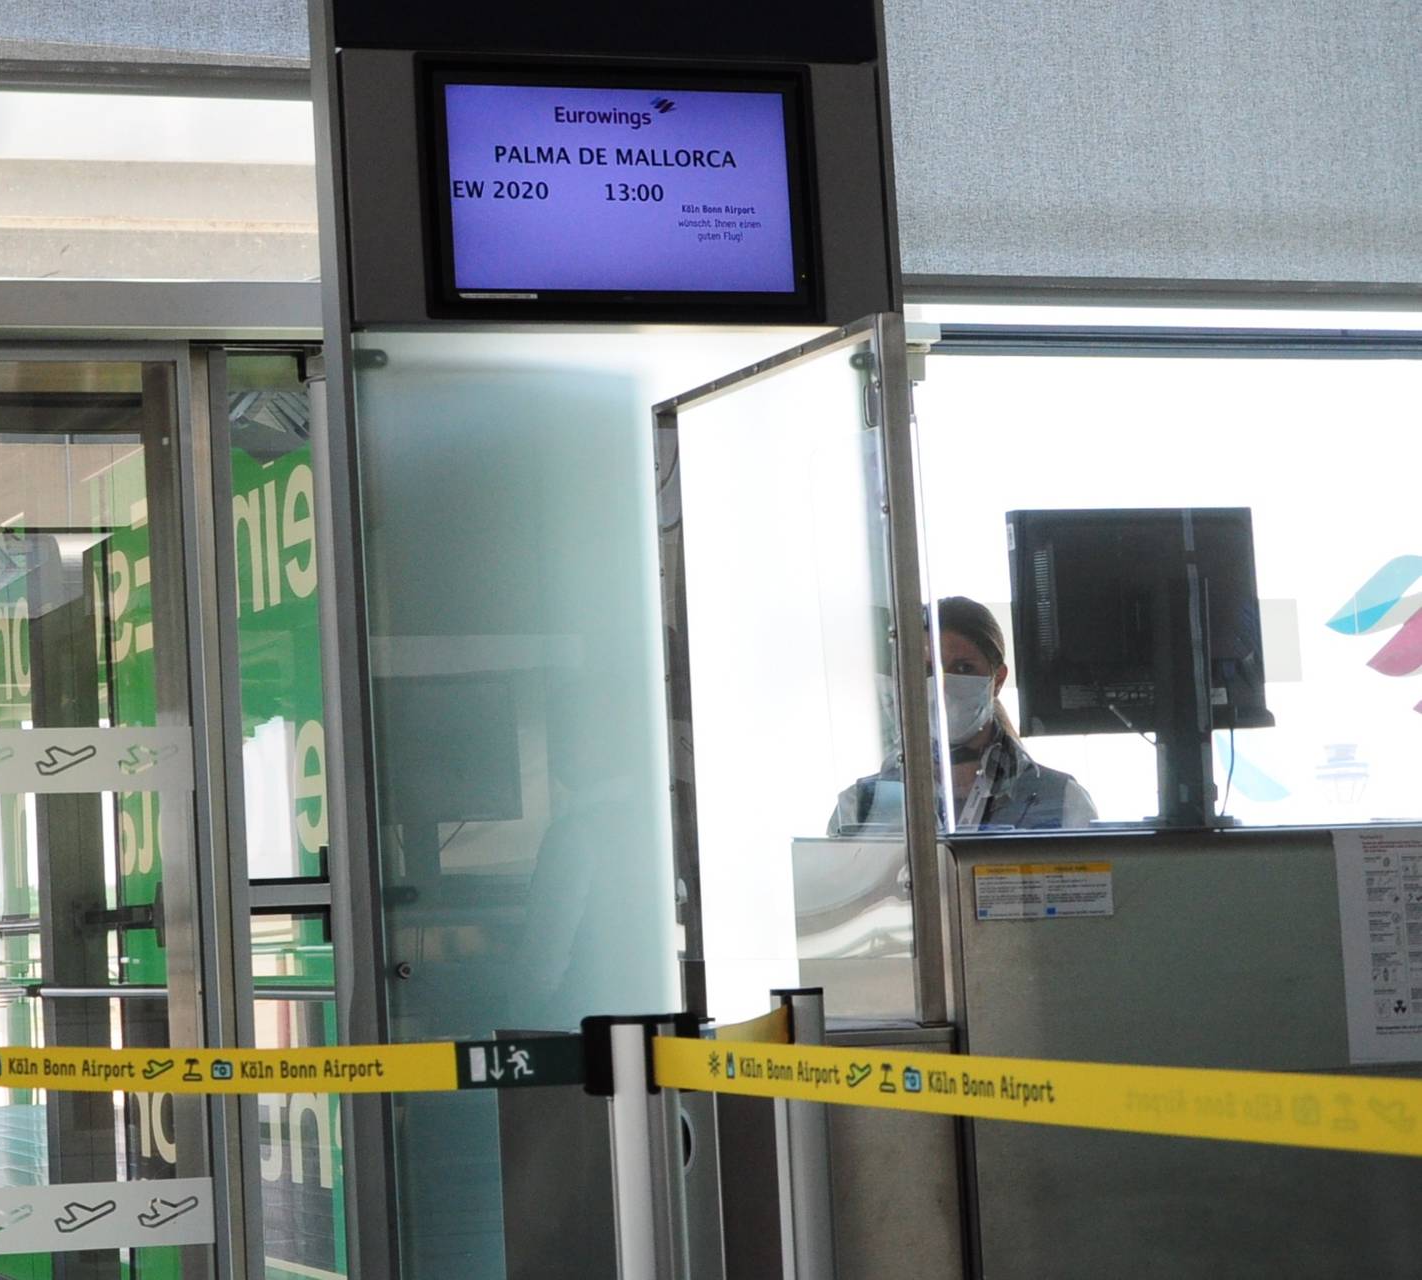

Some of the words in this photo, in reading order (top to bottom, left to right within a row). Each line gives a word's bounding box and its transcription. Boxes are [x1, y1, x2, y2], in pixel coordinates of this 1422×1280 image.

[554, 105, 653, 130] Eurowings
[494, 145, 571, 165] PALMA
[578, 147, 608, 166] DE
[615, 148, 737, 169] MALLORCA
[452, 180, 485, 199] EW
[493, 180, 549, 200] 2020
[605, 183, 664, 202] 13:00
[681, 204, 700, 214] Köln
[702, 204, 723, 214] Bonn
[724, 205, 756, 216] Airport
[678, 219, 712, 228] wünscht
[714, 218, 737, 229] Ihnen
[739, 220, 762, 229] einen
[697, 232, 722, 243] guten
[723, 231, 744, 244] Flug!
[8, 1057, 38, 1075] Köln
[43, 1058, 76, 1076] Bonn
[81, 1059, 135, 1081] Airport
[240, 1060, 274, 1079] Köln
[279, 1060, 317, 1079] Bonn
[323, 1059, 384, 1082] Airport
[739, 1057, 763, 1079] Köln
[766, 1058, 793, 1080] Bonn
[797, 1060, 841, 1086] Airport
[927, 1071, 957, 1095] Köln
[962, 1072, 995, 1097] Bonn
[1000, 1075, 1055, 1106] Airport
